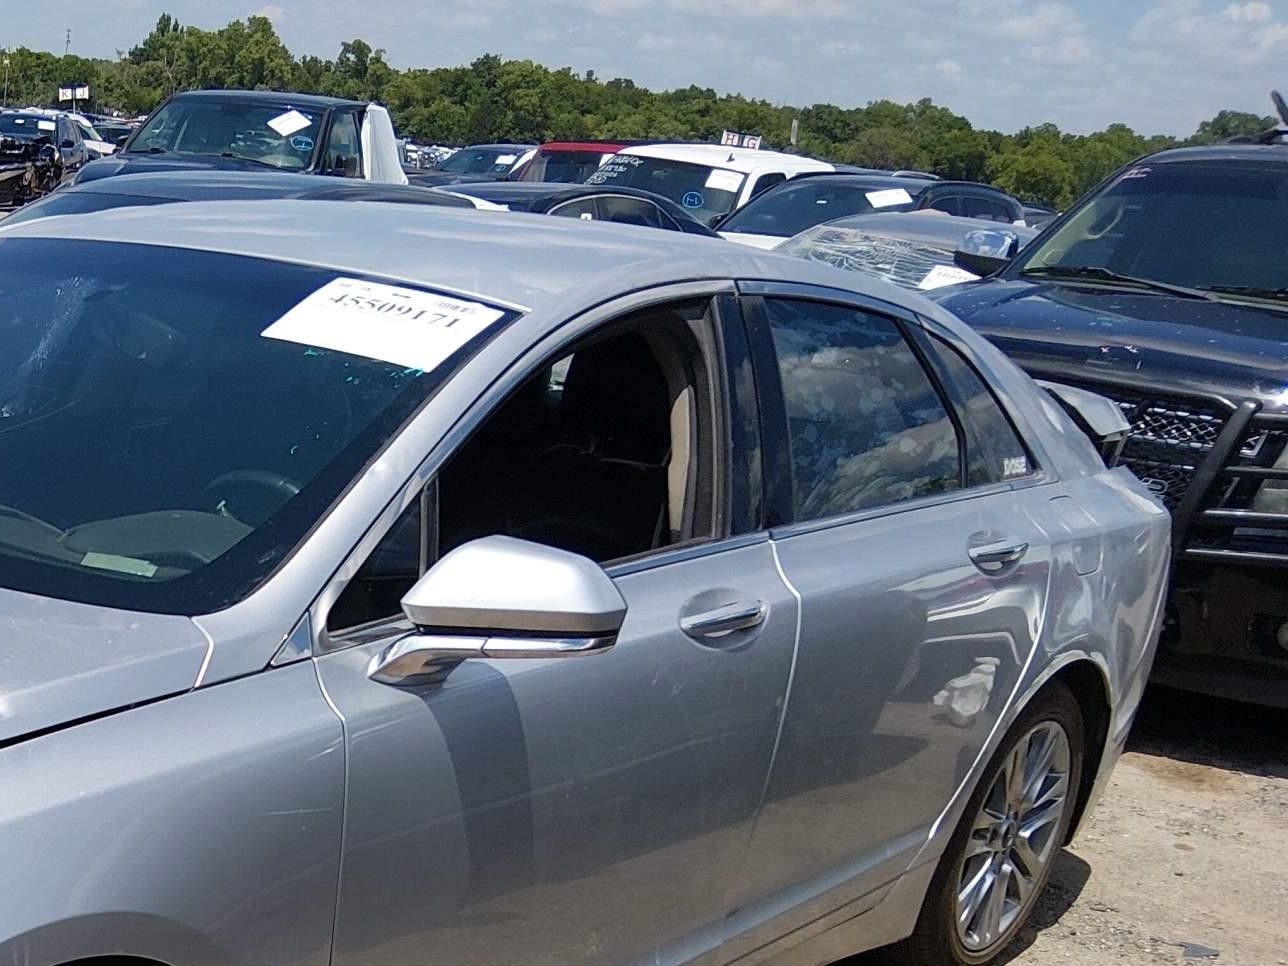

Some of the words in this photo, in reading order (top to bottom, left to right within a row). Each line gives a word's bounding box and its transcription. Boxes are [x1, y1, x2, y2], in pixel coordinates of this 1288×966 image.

[725, 133, 735, 146] H
[747, 137, 757, 148] G
[329, 293, 461, 328] 45509171
